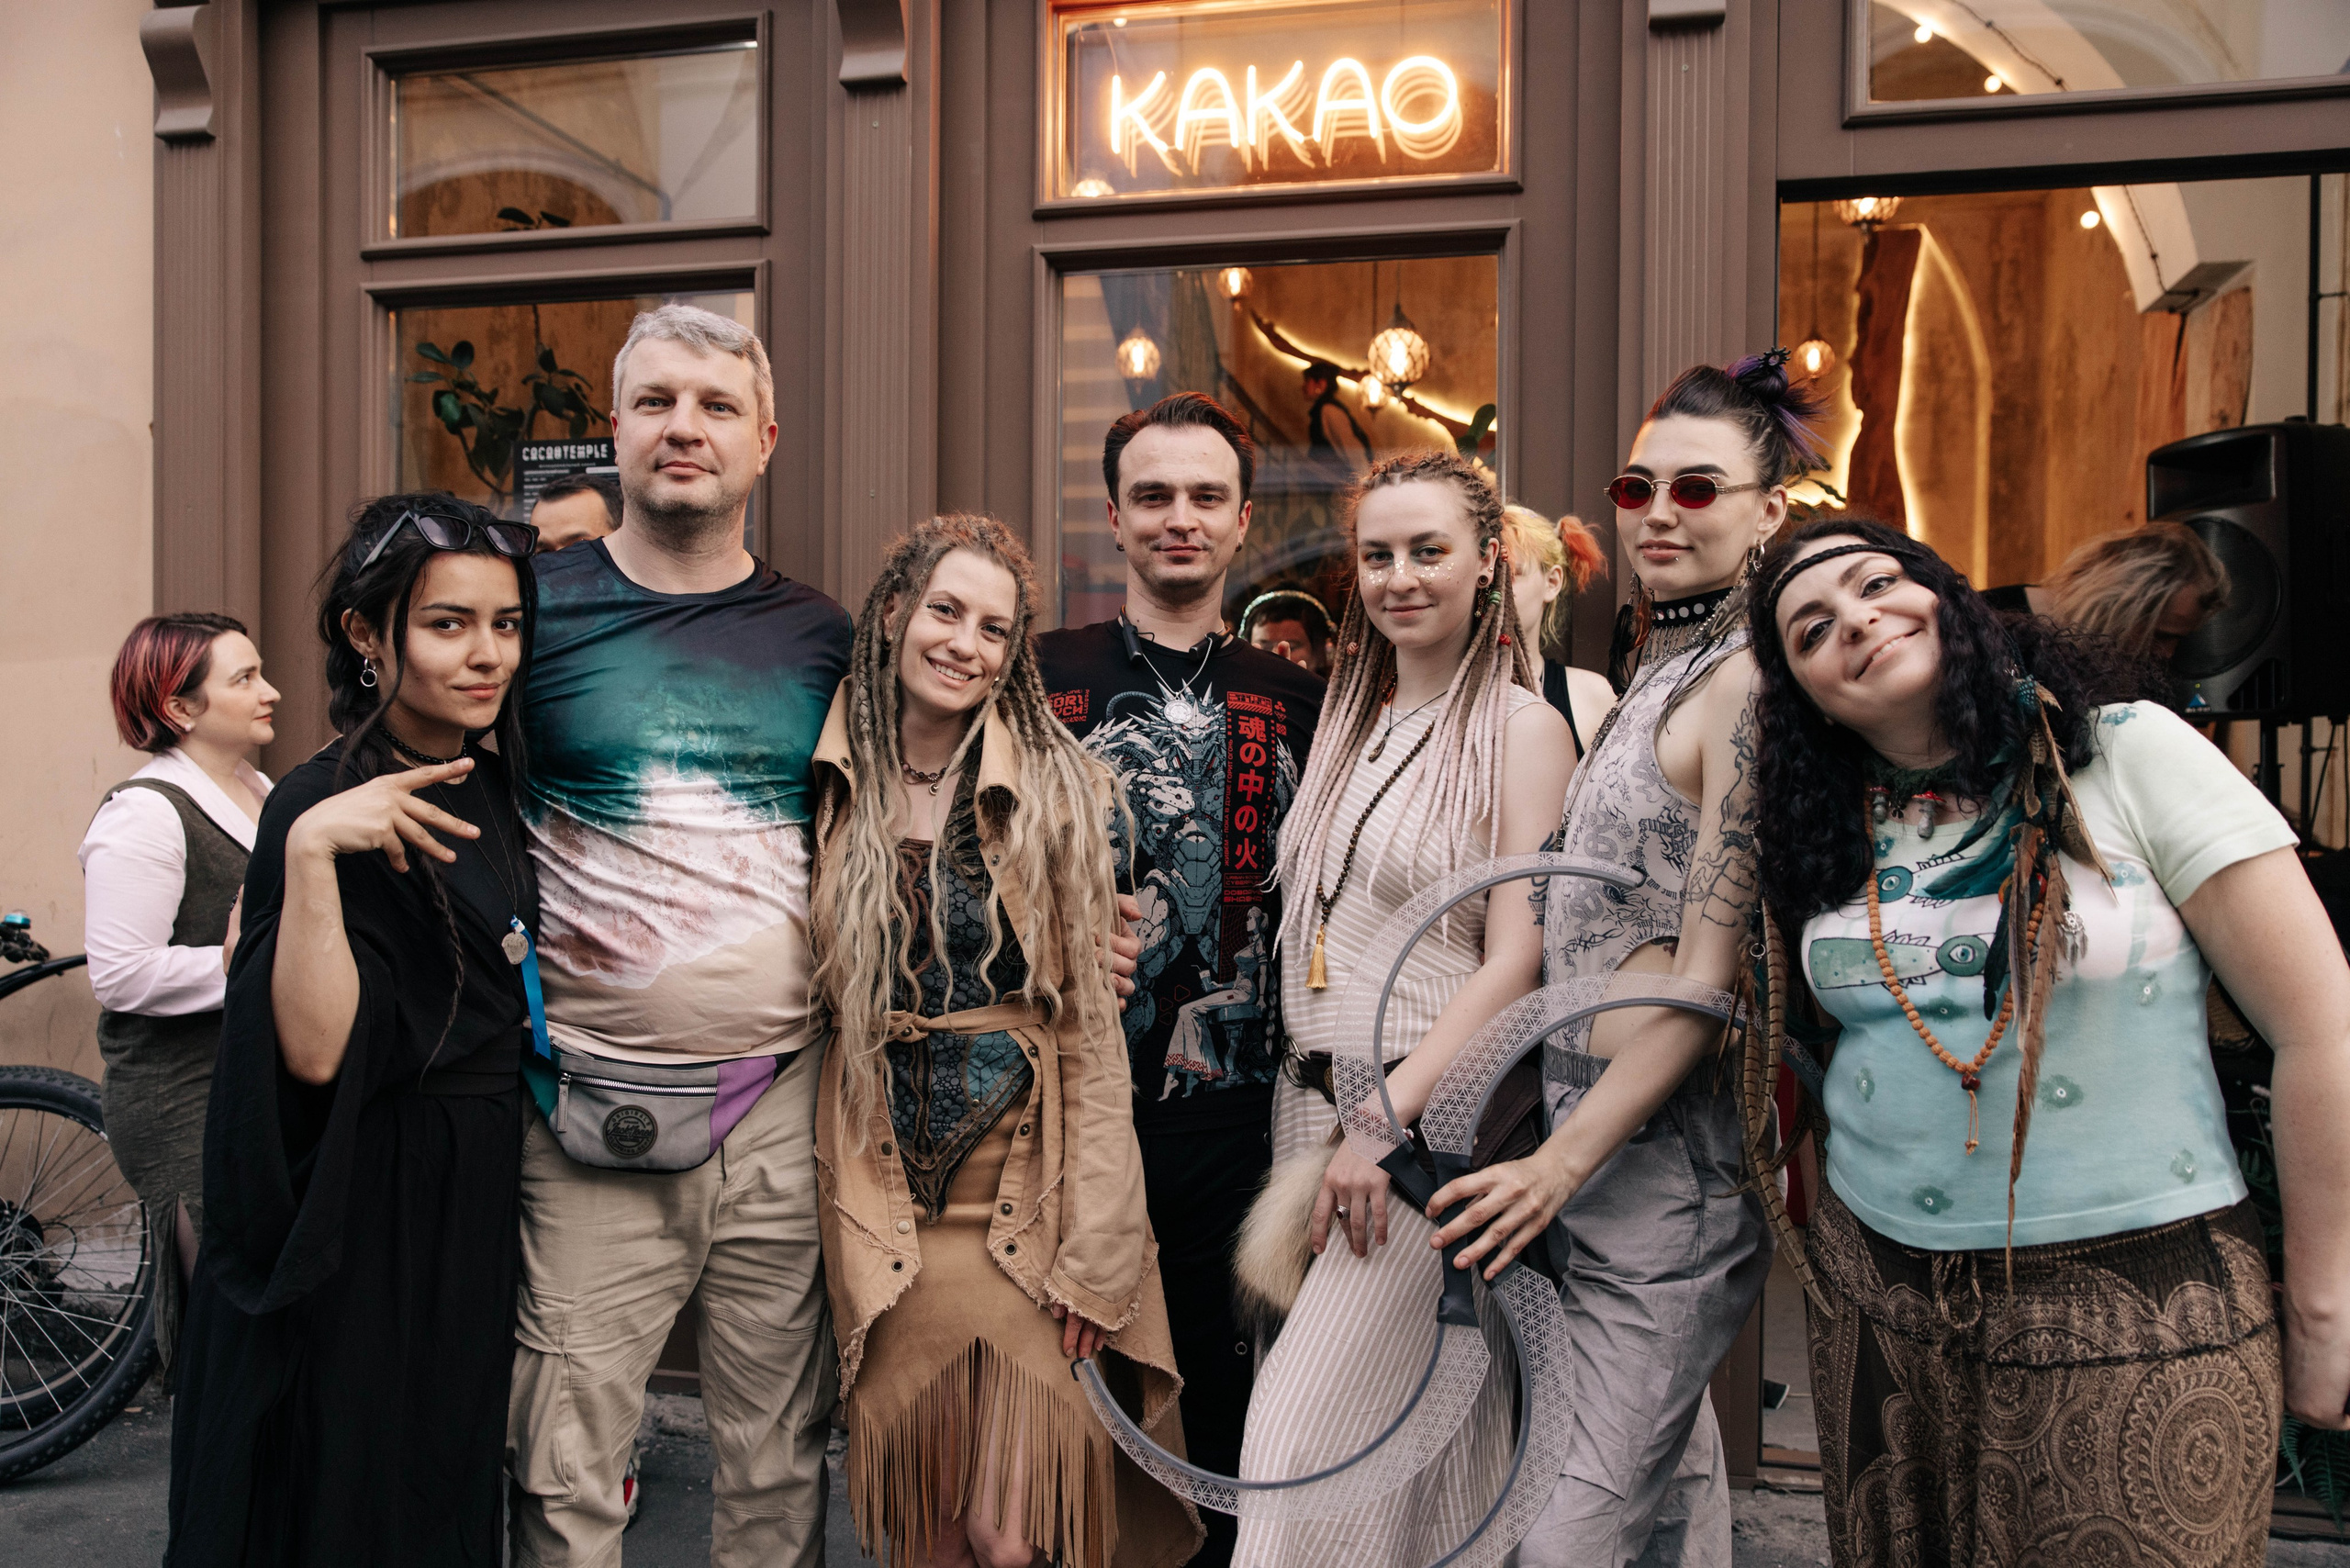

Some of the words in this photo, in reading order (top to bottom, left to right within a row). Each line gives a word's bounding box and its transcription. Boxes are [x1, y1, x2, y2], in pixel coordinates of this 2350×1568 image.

[1111, 55, 1458, 154] KAKAO
[1053, 705, 1083, 718] YCH
[1235, 716, 1267, 870] 魂の中の火
[1637, 919, 1653, 929] only
